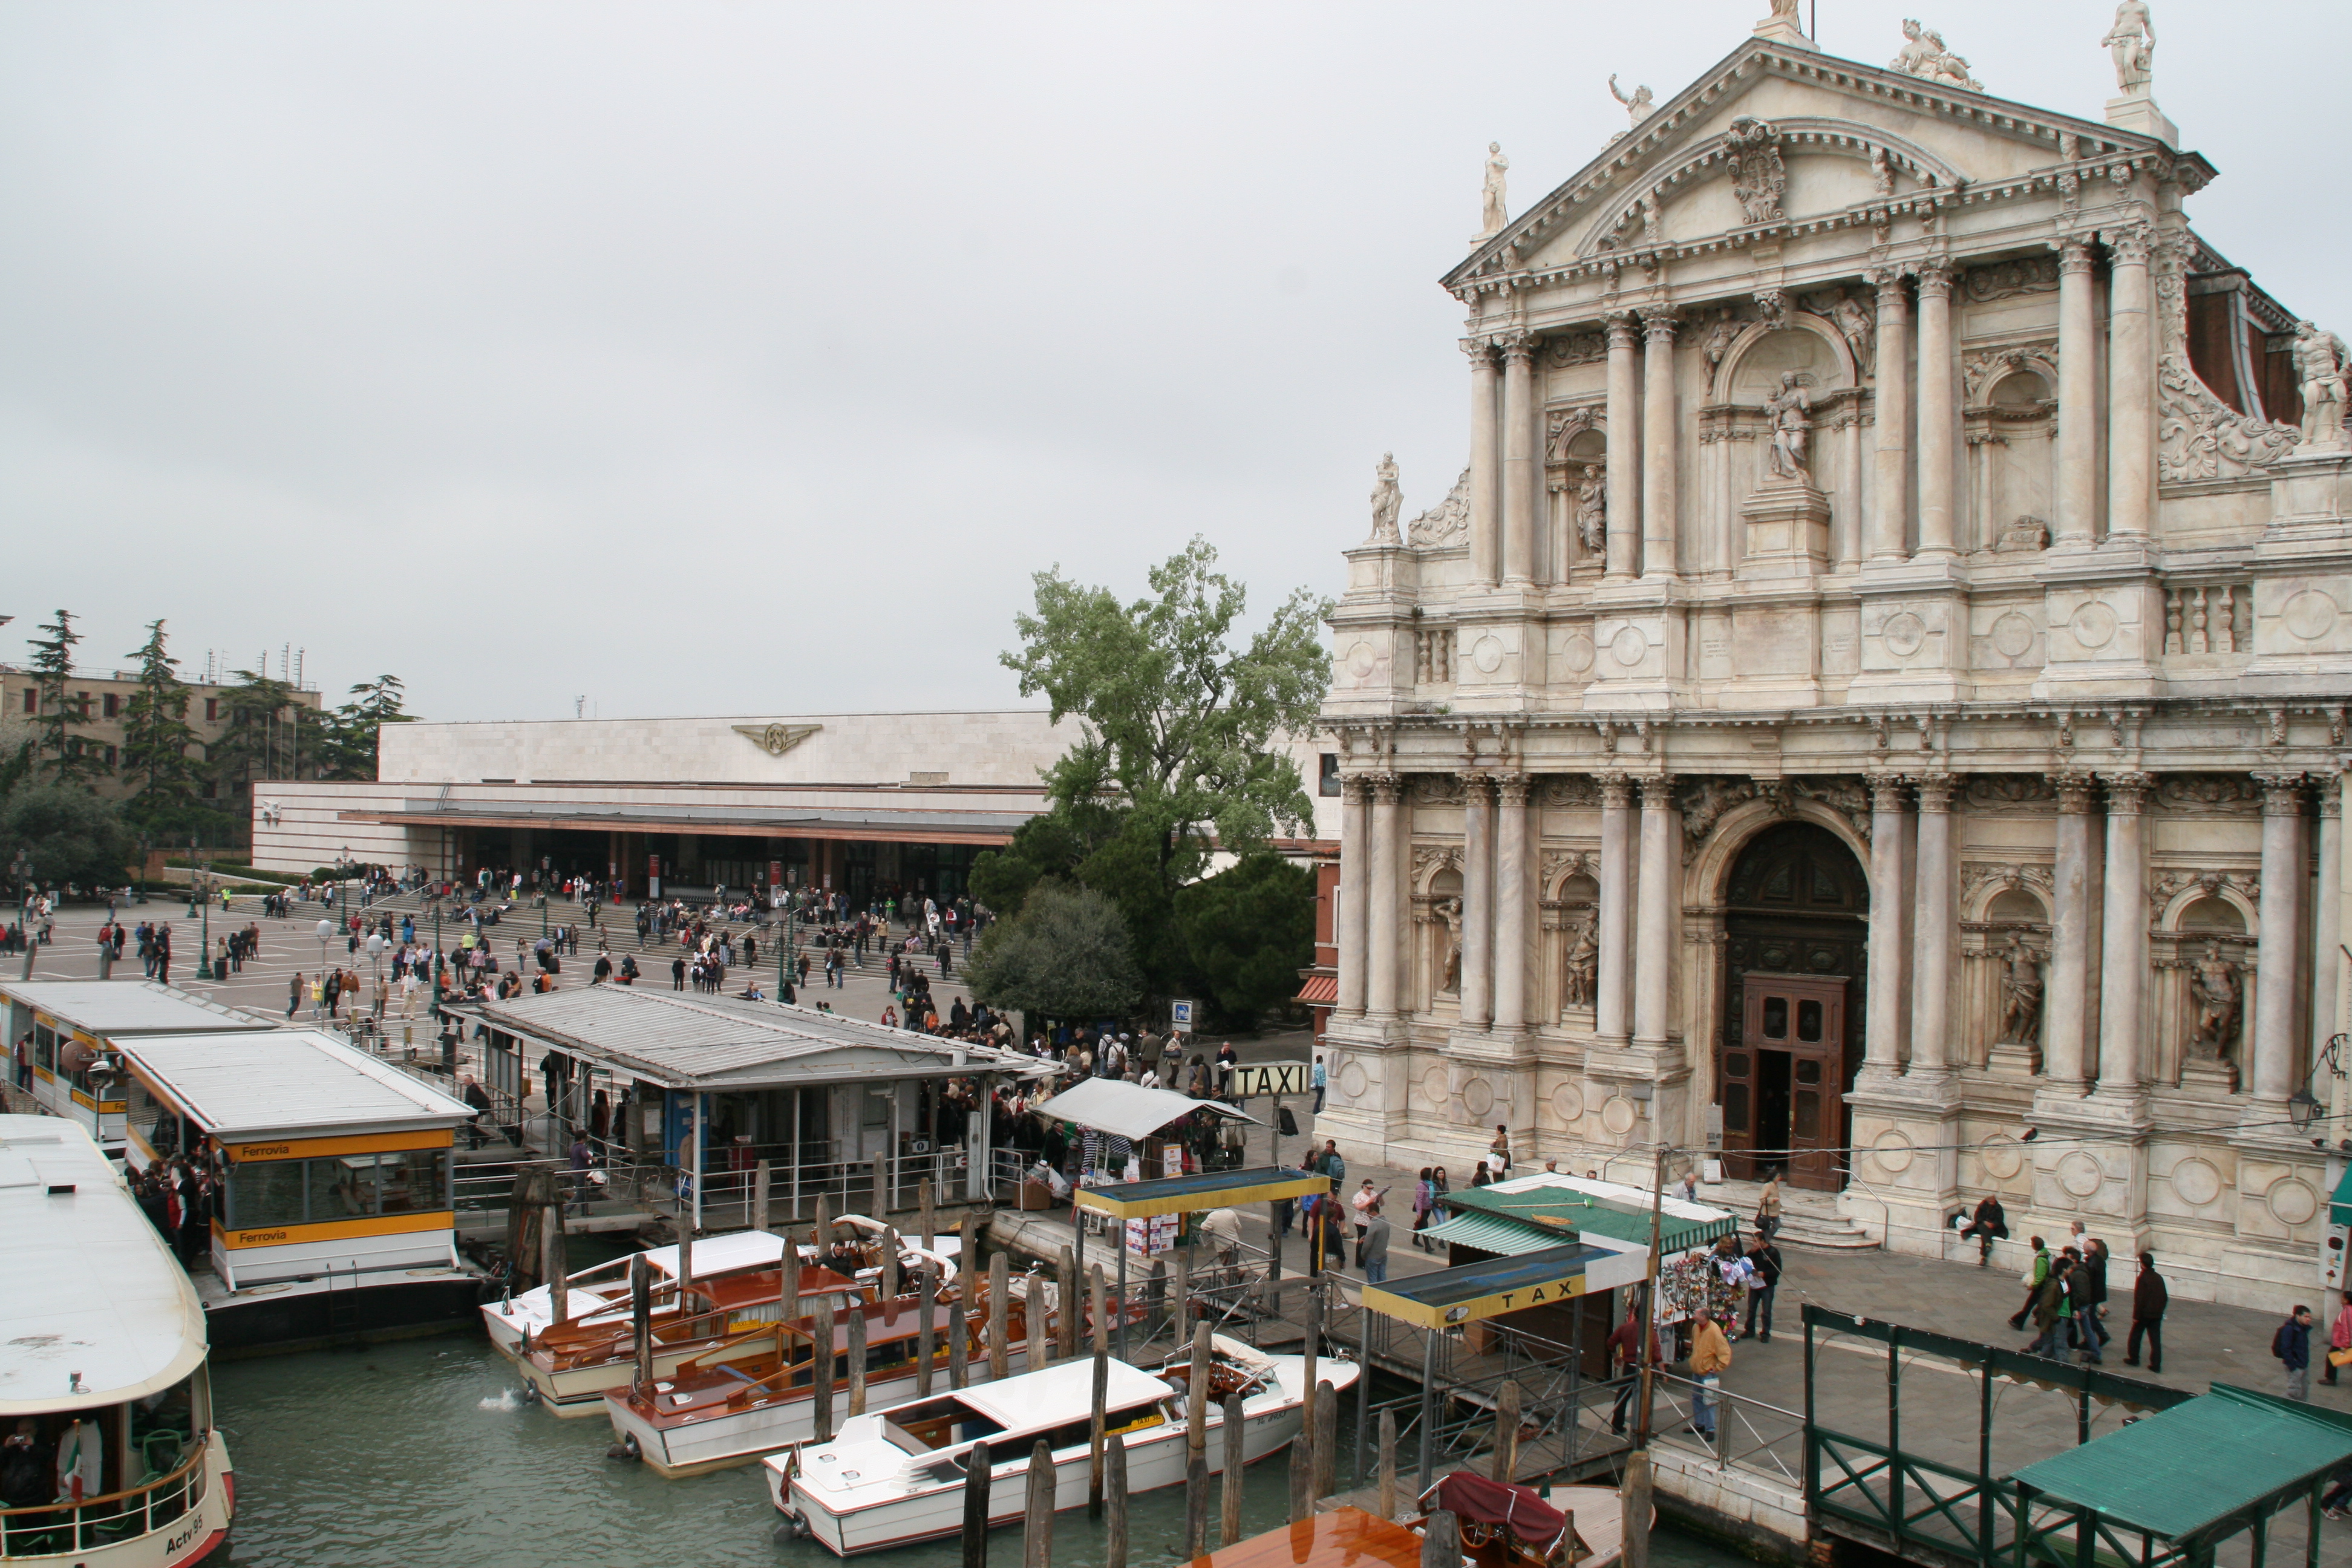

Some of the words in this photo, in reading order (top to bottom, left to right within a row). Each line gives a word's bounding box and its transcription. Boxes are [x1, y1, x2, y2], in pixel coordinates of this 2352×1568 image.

[1238, 1067, 1303, 1096] TAXI
[243, 1144, 289, 1157] Ferrovia
[240, 1230, 287, 1243] Ferrovia
[1501, 1280, 1572, 1308] TAX
[165, 1528, 192, 1555] Actv
[194, 1513, 203, 1534] 95
